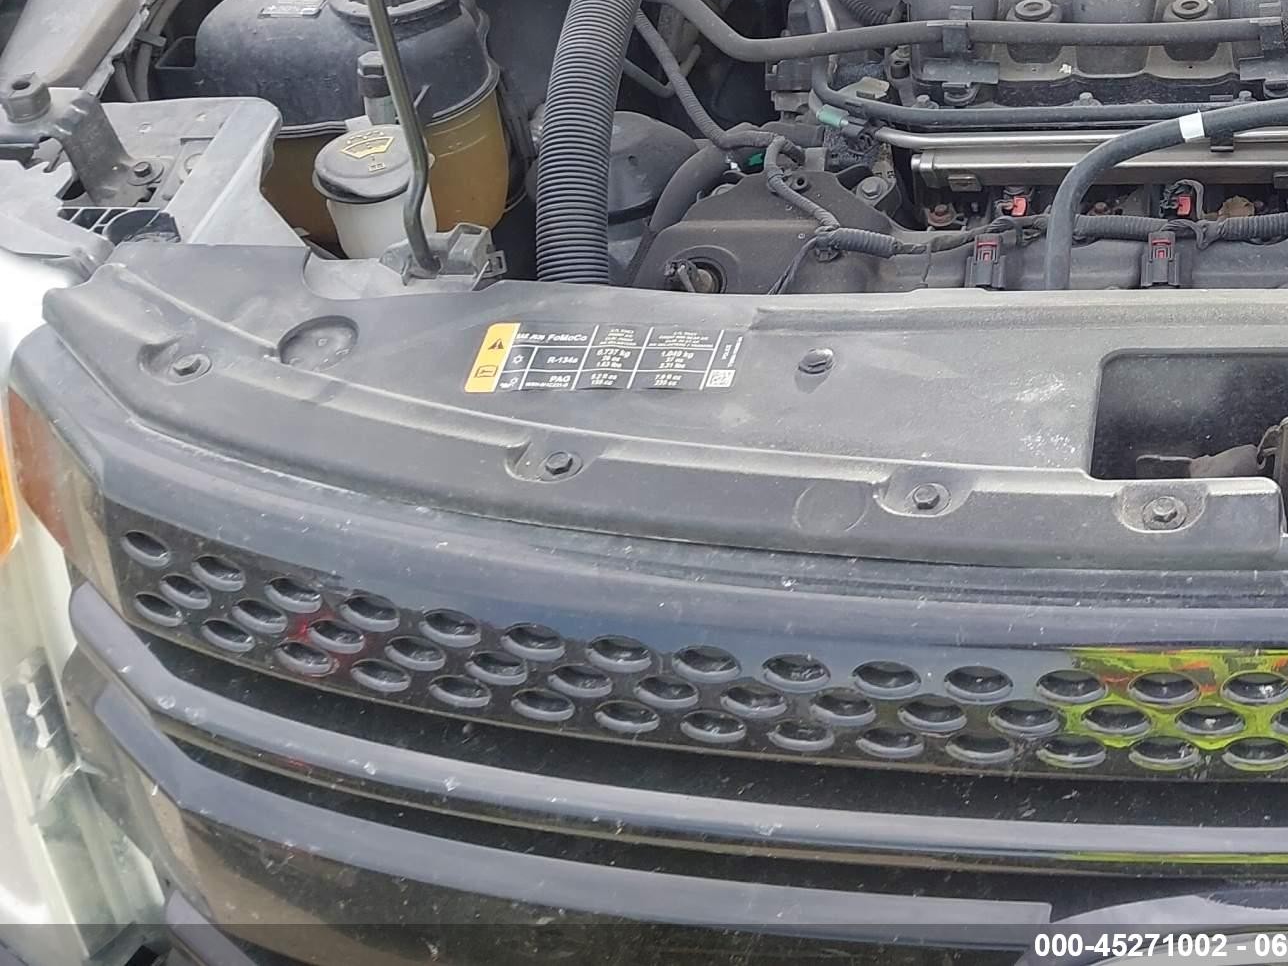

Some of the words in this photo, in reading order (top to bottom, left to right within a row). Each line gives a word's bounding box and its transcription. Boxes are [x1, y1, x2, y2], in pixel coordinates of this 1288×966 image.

[545, 333, 588, 342] FoMoCo
[619, 349, 632, 359] kg
[683, 350, 695, 360] kg
[546, 356, 579, 364] R-134a
